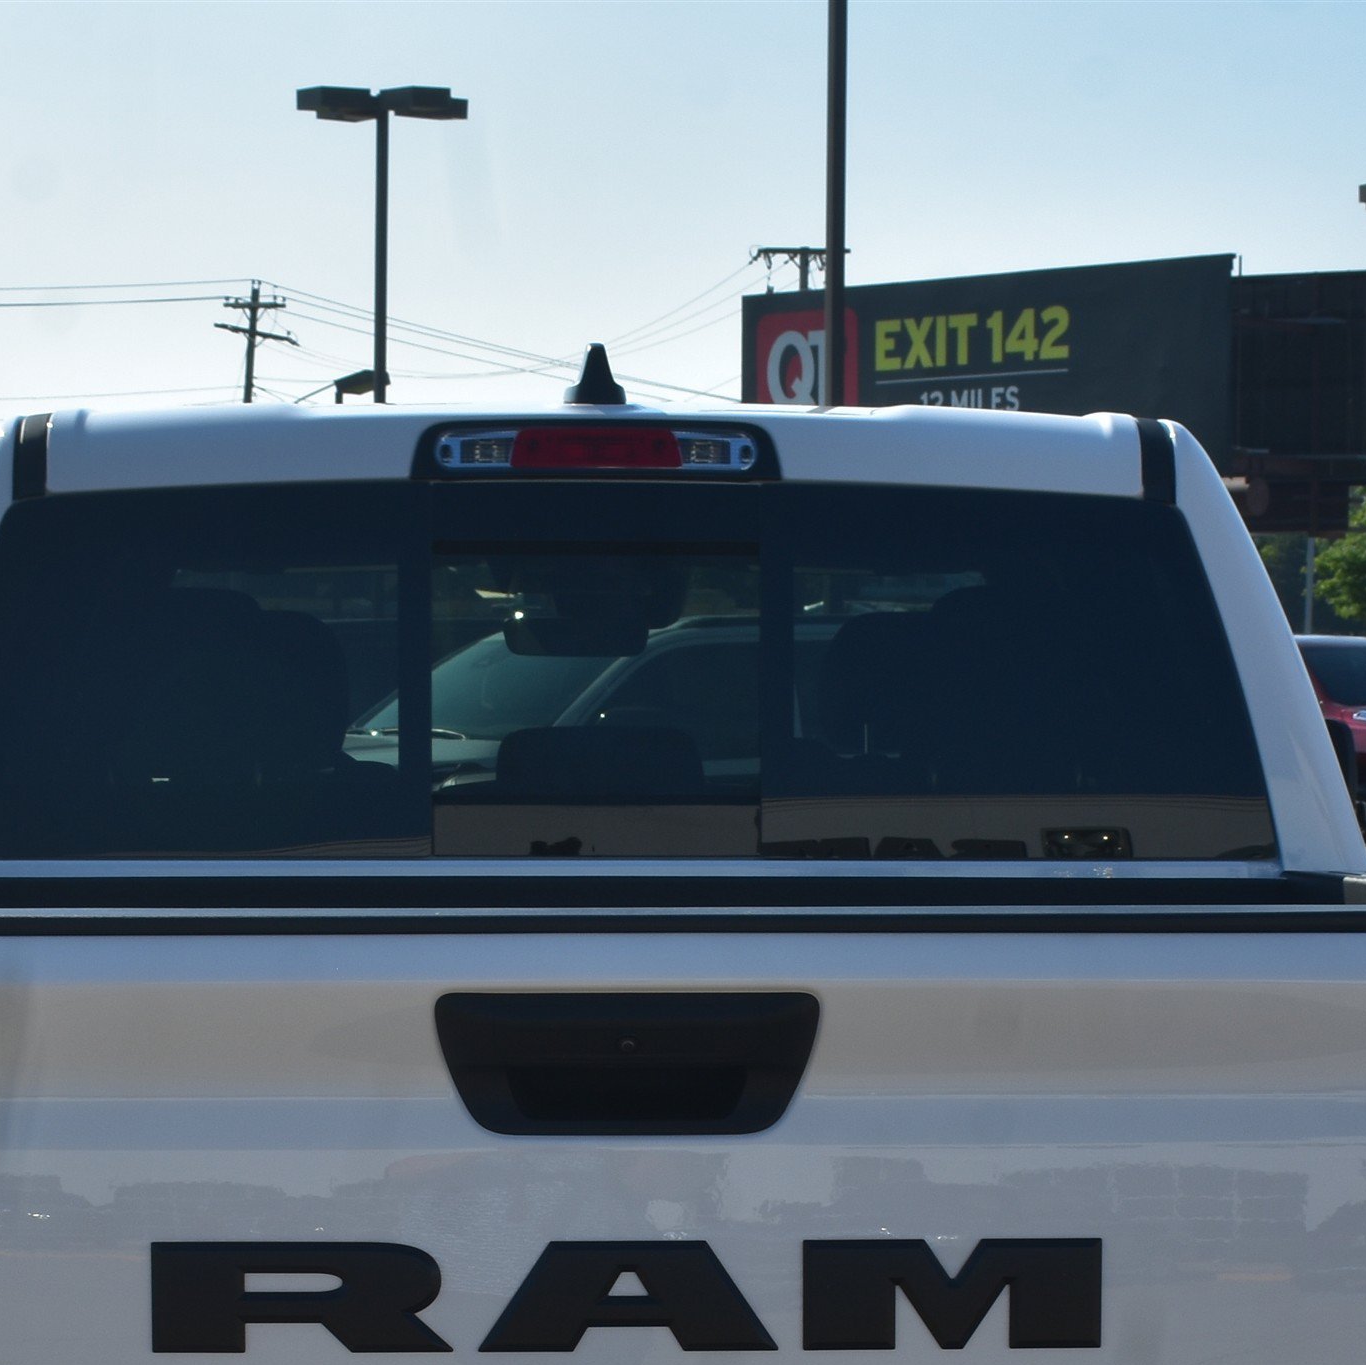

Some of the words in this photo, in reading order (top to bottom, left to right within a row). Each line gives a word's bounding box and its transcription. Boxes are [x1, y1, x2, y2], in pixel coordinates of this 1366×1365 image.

[875, 313, 978, 371] EXIT
[986, 305, 1070, 364] 142
[951, 385, 1020, 411] MILES
[151, 1237, 1102, 1354] RAM
